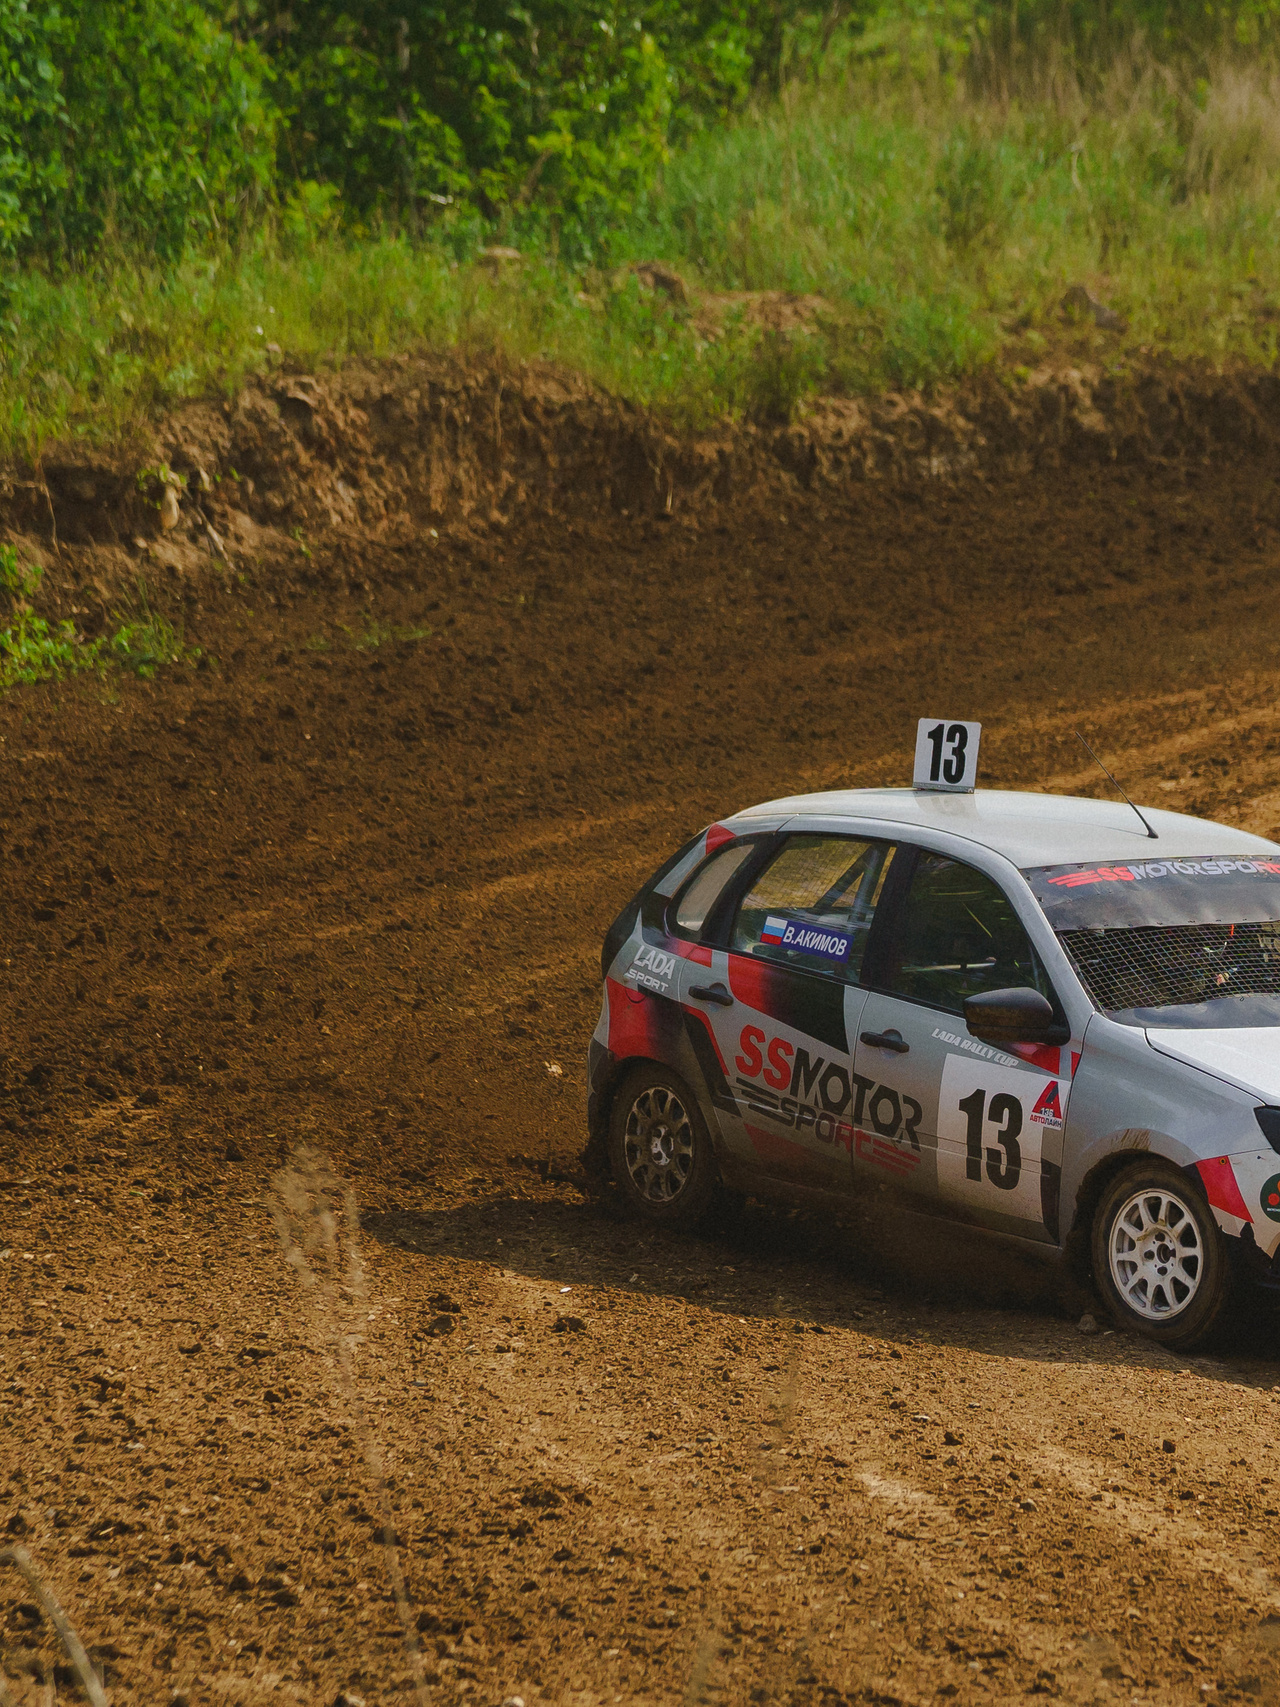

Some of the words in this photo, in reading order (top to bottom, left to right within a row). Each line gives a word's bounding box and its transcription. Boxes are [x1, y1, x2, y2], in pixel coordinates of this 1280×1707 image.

[927, 723, 968, 784] 13
[782, 926, 848, 956] В.АКИМОВ
[624, 969, 669, 992] SPORT
[633, 945, 676, 979] LADA
[931, 1028, 962, 1046] LADA
[960, 1039, 997, 1059] RALLY
[993, 1052, 1019, 1067] CUP
[735, 1024, 921, 1152] SSMOTOR
[958, 1088, 1023, 1190] 13
